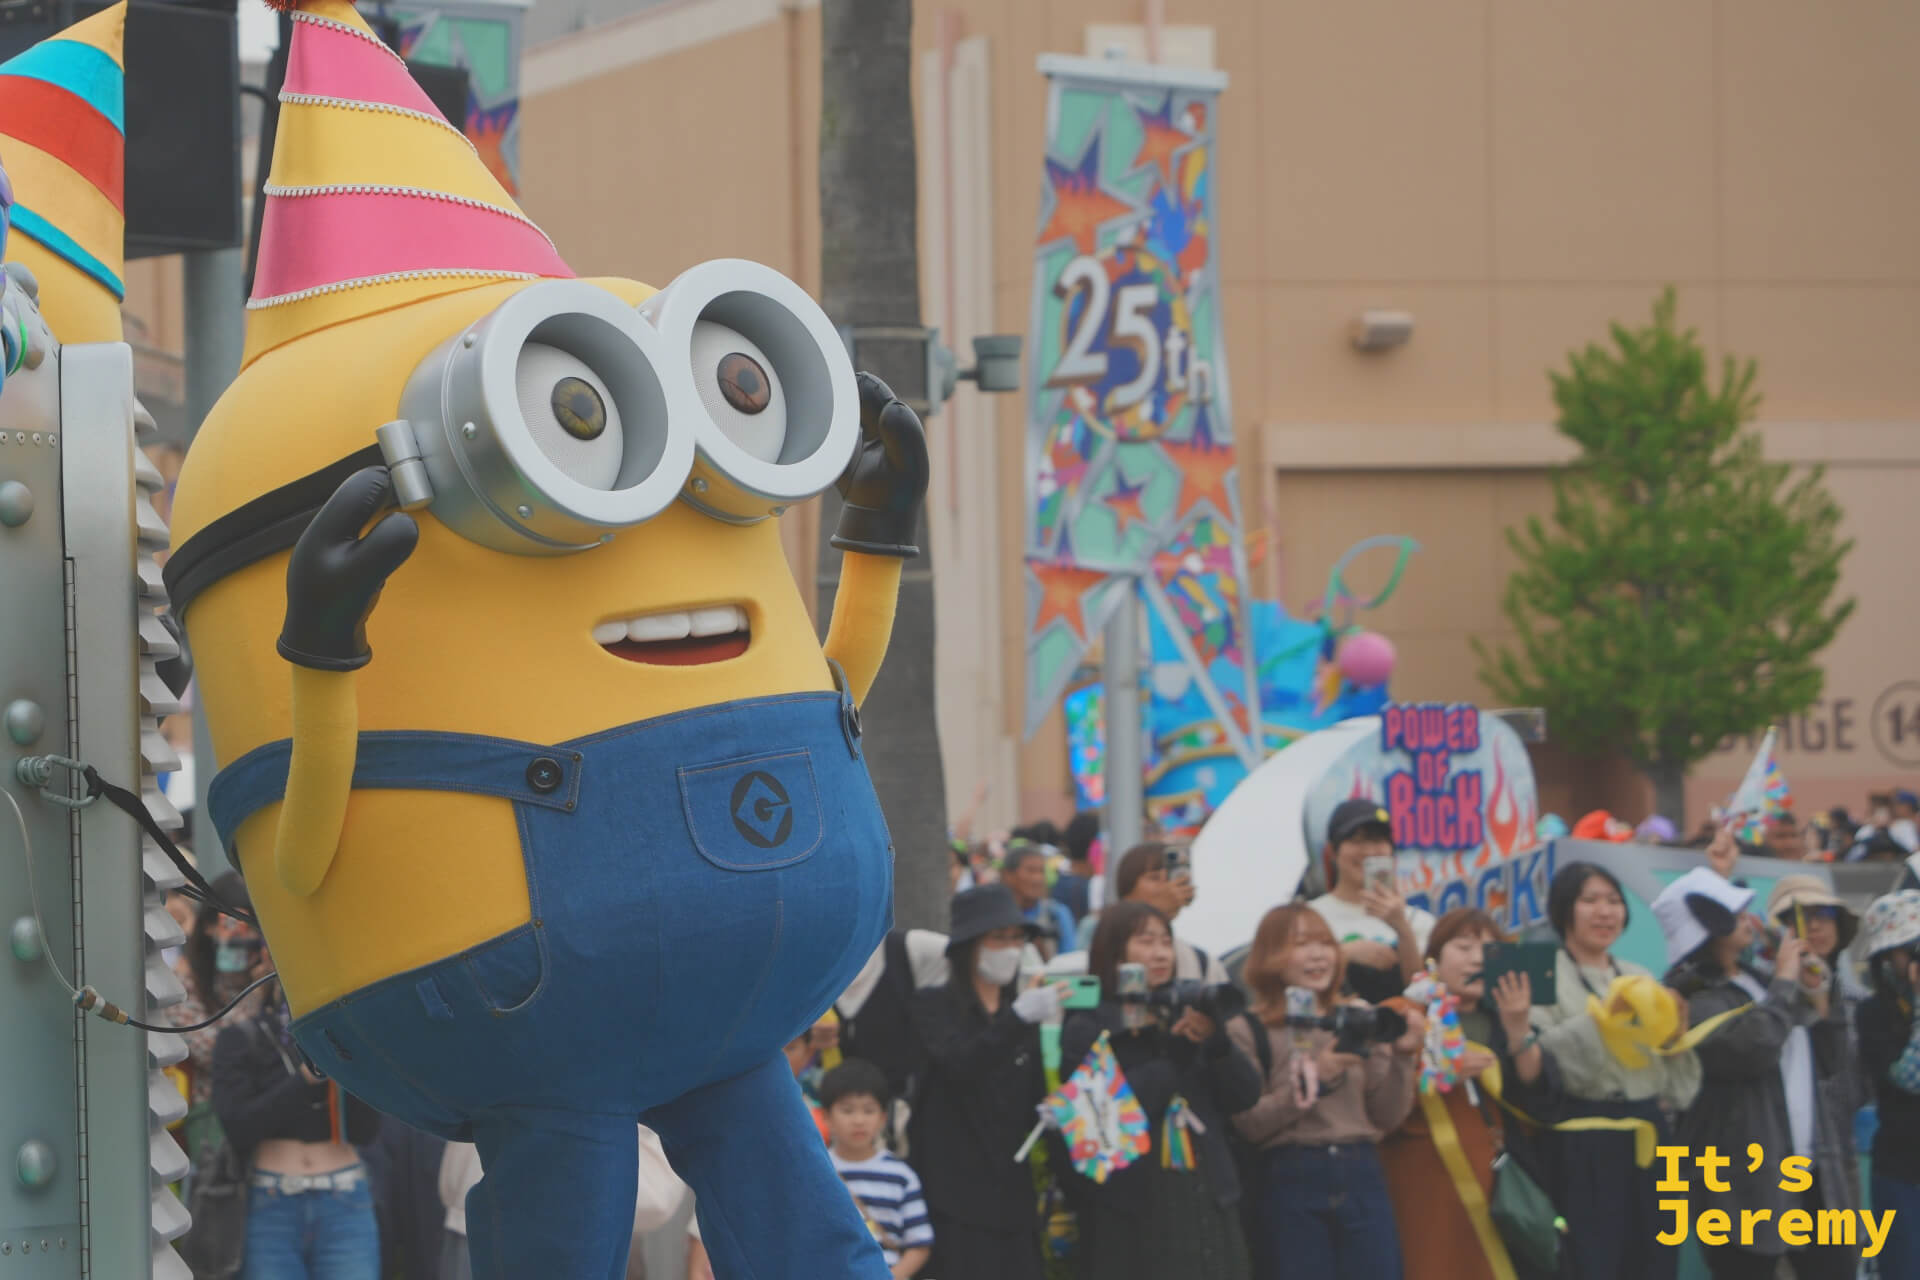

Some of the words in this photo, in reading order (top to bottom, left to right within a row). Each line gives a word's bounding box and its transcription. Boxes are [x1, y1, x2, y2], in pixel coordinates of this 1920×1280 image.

[1048, 255, 1213, 414] 25th
[1384, 704, 1480, 751] POWER
[1720, 699, 1856, 751] AGE
[1417, 751, 1449, 790] OF
[1388, 771, 1482, 847] ROCK
